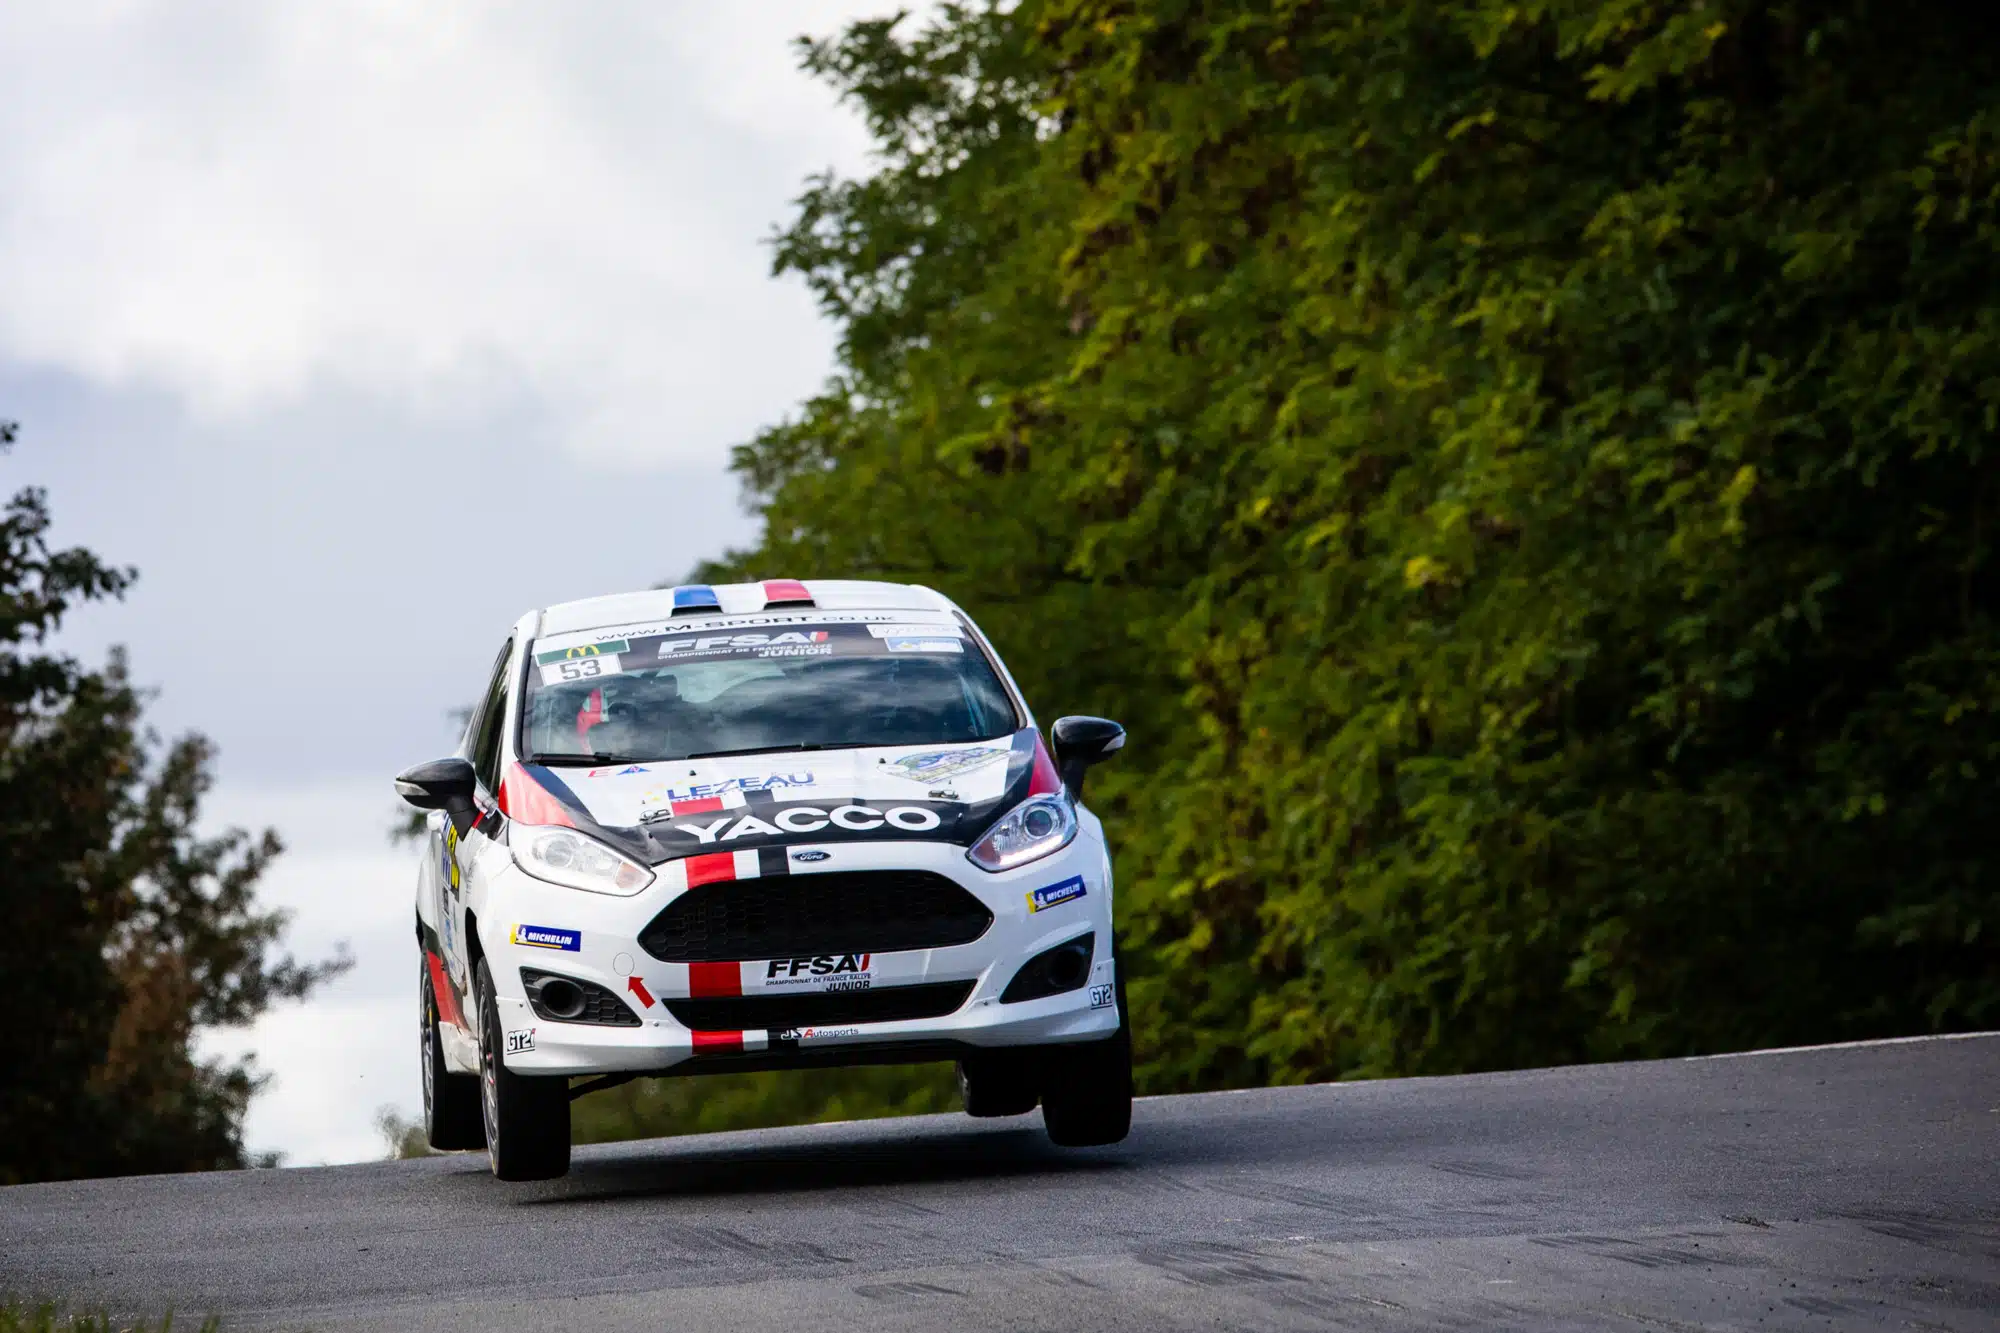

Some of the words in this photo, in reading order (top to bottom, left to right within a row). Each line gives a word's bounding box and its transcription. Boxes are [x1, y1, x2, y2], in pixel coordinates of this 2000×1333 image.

[657, 649, 732, 660] CHAMPIONNAT
[752, 644, 795, 652] FRANCE
[658, 631, 813, 655] FFSA
[758, 647, 832, 658] JUNIOR
[559, 659, 602, 681] 53
[667, 769, 815, 800] LEZEAU
[674, 805, 941, 844] YACCO
[1046, 882, 1081, 902] MICHELIN
[527, 931, 573, 945] MICHELIN
[767, 954, 859, 978] FFSA
[765, 978, 811, 986] CHAMPIONNAT
[823, 975, 848, 983] FRANCE
[826, 980, 871, 992] JUNIOR
[803, 1028, 859, 1039] Autosports
